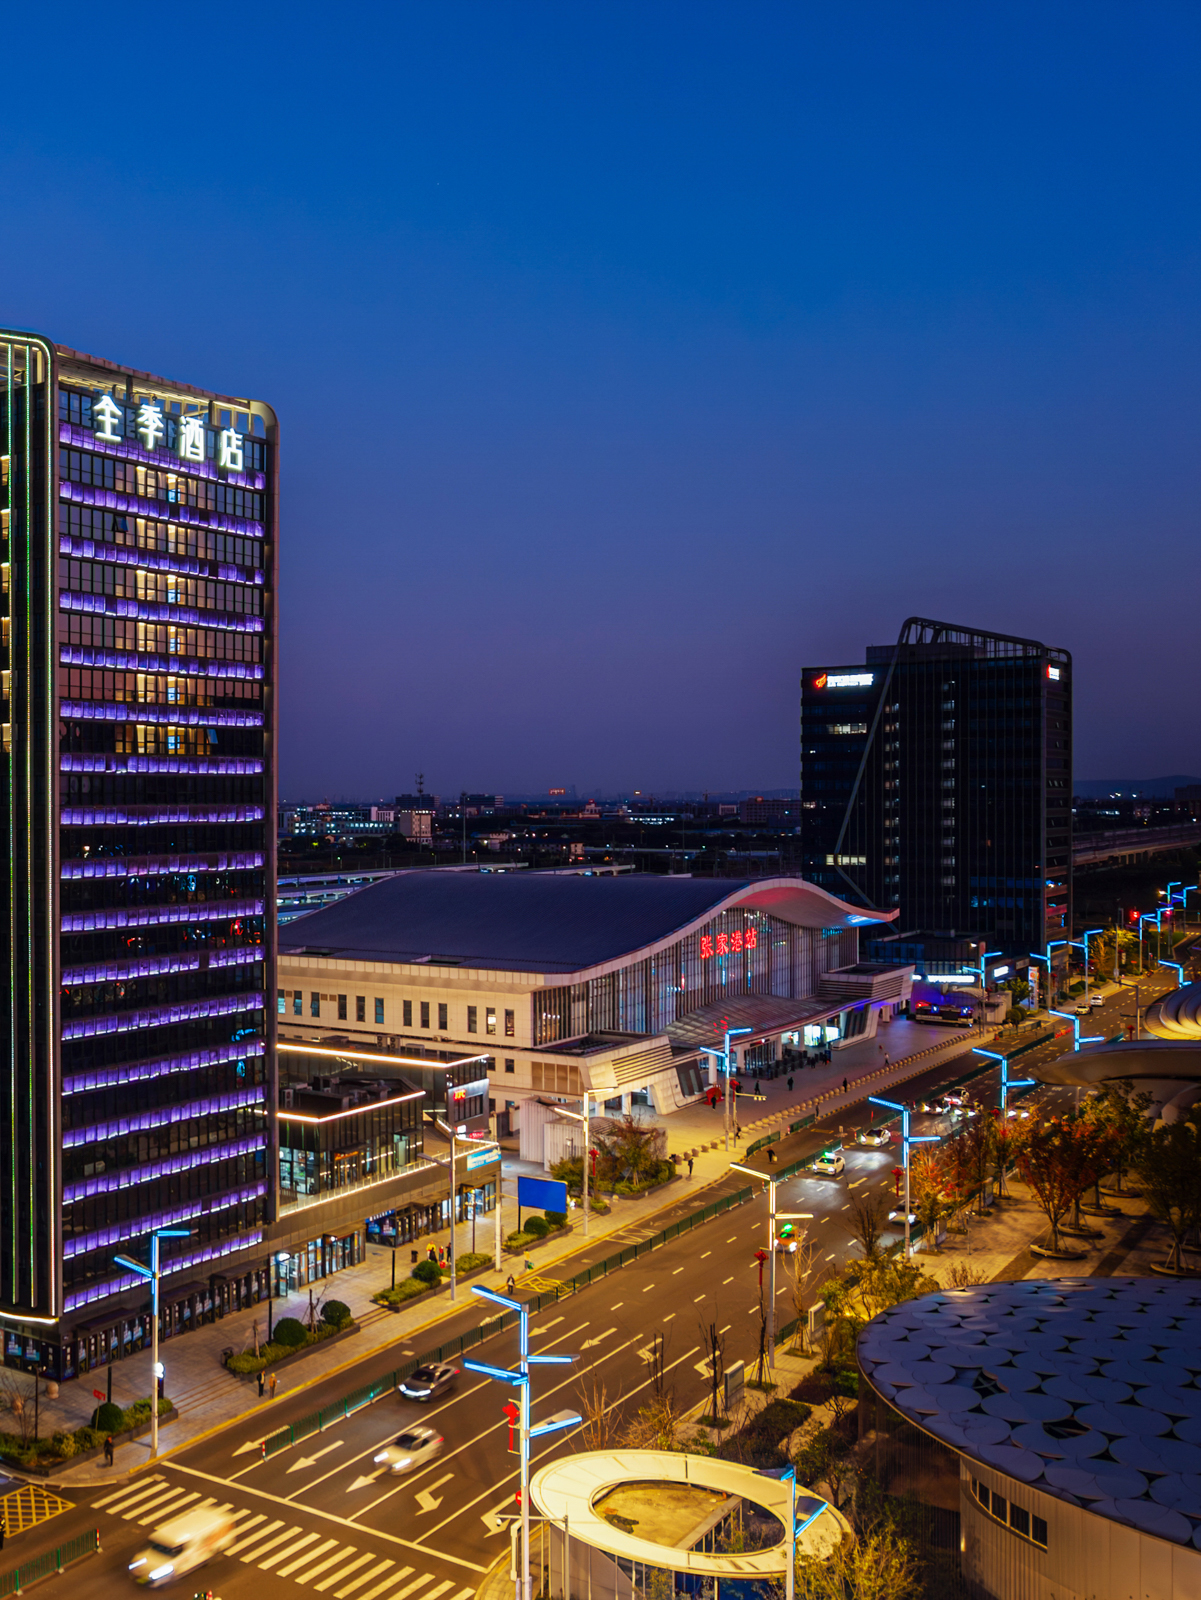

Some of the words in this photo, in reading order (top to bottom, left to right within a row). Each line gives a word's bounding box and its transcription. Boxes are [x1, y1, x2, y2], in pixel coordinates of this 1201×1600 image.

[94, 395, 244, 471] 全季酒店
[700, 926, 758, 960] 张家港站
